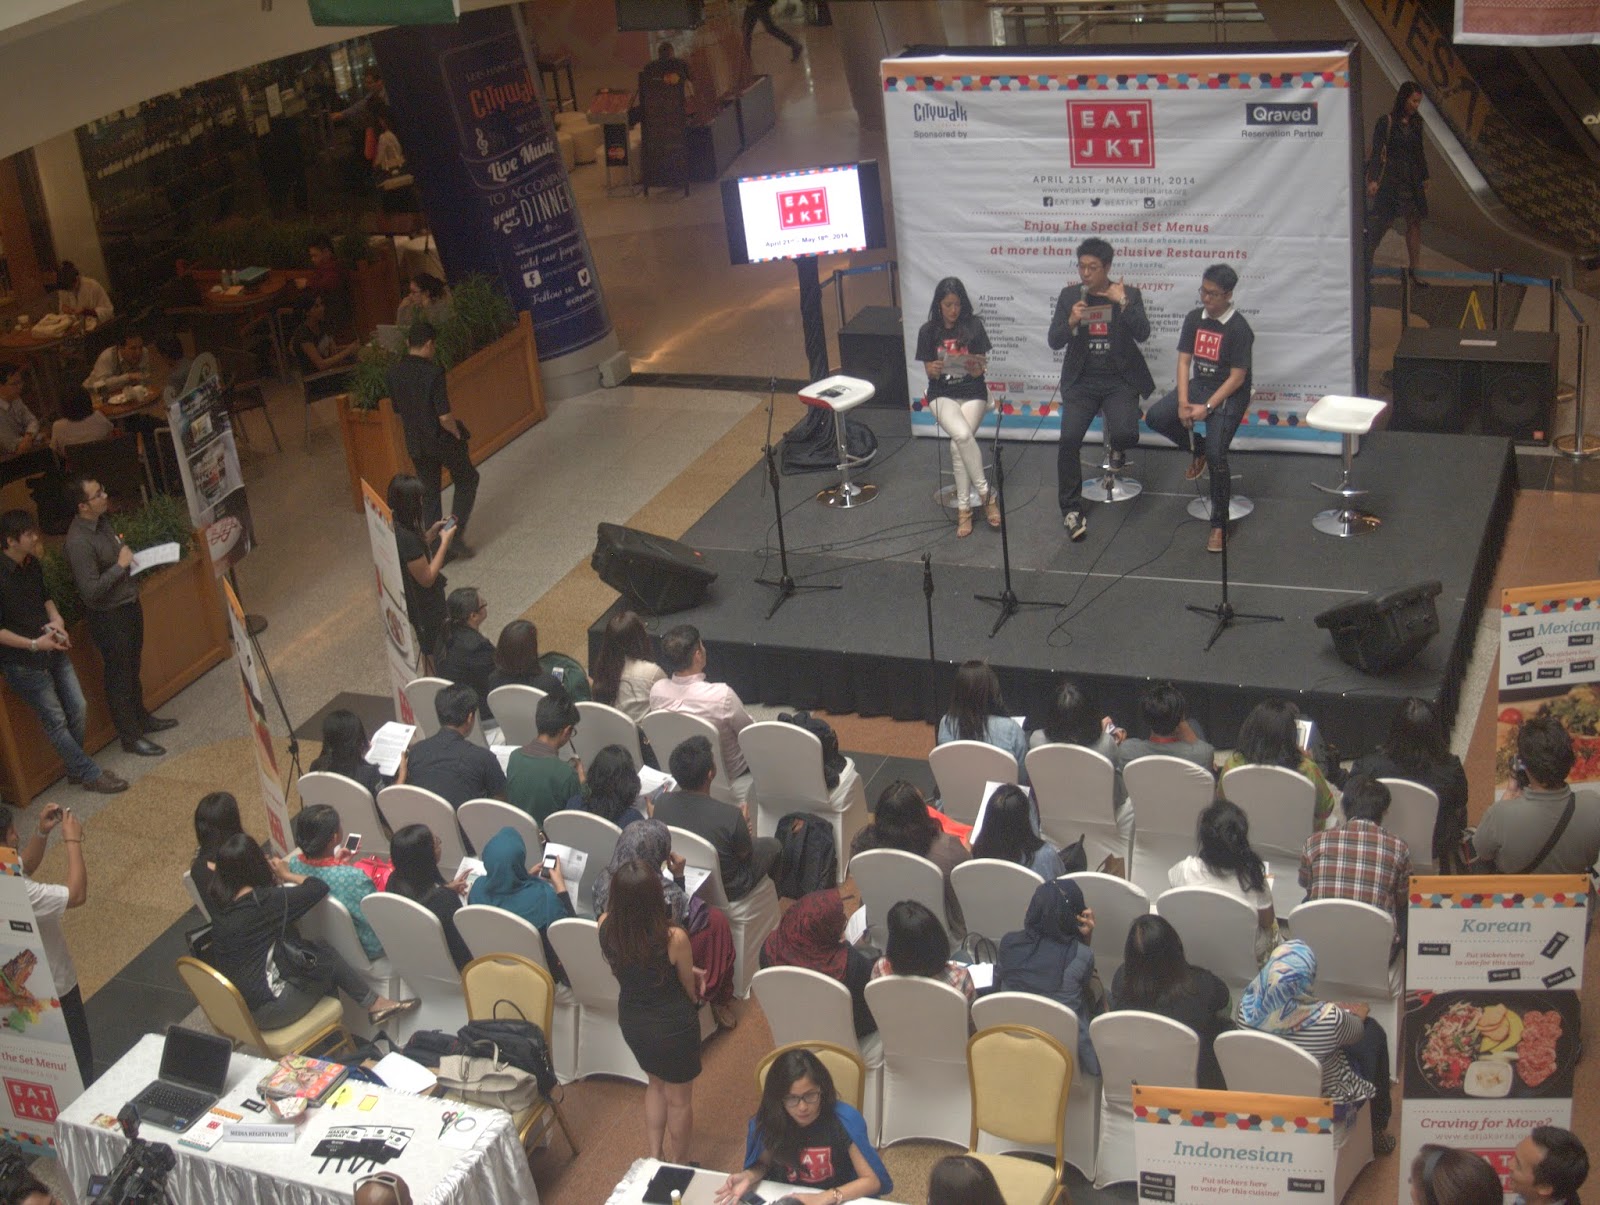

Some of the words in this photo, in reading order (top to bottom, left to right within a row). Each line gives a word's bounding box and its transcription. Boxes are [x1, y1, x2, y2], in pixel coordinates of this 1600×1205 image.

[1080, 110, 1142, 128] EAT
[1253, 106, 1311, 122] Qraved
[914, 131, 956, 139] Sponsored
[957, 131, 968, 139] by
[1241, 130, 1290, 138] Reservation
[1294, 130, 1324, 138] Partner
[1080, 139, 1144, 158] JKT
[488, 157, 519, 182] Live
[1033, 176, 1064, 184] APRIL
[1069, 176, 1093, 184] 21ST
[1106, 177, 1128, 185] MAY
[1134, 177, 1165, 185] 18TH,
[1169, 177, 1195, 185] 2014
[784, 192, 821, 208] EAT
[786, 209, 823, 224] JKT
[1024, 220, 1060, 233] Enjoy
[1064, 220, 1087, 231] The
[1091, 221, 1138, 234] Special
[1142, 221, 1161, 232] Set
[1166, 222, 1209, 233] Menus
[802, 236, 816, 244] May
[833, 232, 848, 240] 2014
[990, 246, 1004, 255] at
[1007, 247, 1039, 256] more
[1043, 245, 1073, 256] than
[1112, 246, 1162, 257] xclusive
[1166, 247, 1248, 259] Restaurants
[1200, 334, 1219, 344] EAT
[1537, 620, 1600, 636] Mexican
[1461, 919, 1532, 934] Korean
[2, 1053, 18, 1063] the
[19, 1054, 34, 1065] Set
[36, 1059, 67, 1072] Menu!
[12, 1085, 49, 1101] EAT
[17, 1103, 54, 1118] JKT
[1420, 1117, 1479, 1131] Craving
[1480, 1117, 1504, 1131] for
[230, 1130, 248, 1138] MEDIA
[249, 1130, 289, 1138] REGISTRATION
[1173, 1140, 1294, 1164] Indonesian
[1202, 1176, 1216, 1184] Put
[1217, 1178, 1247, 1187] stickers
